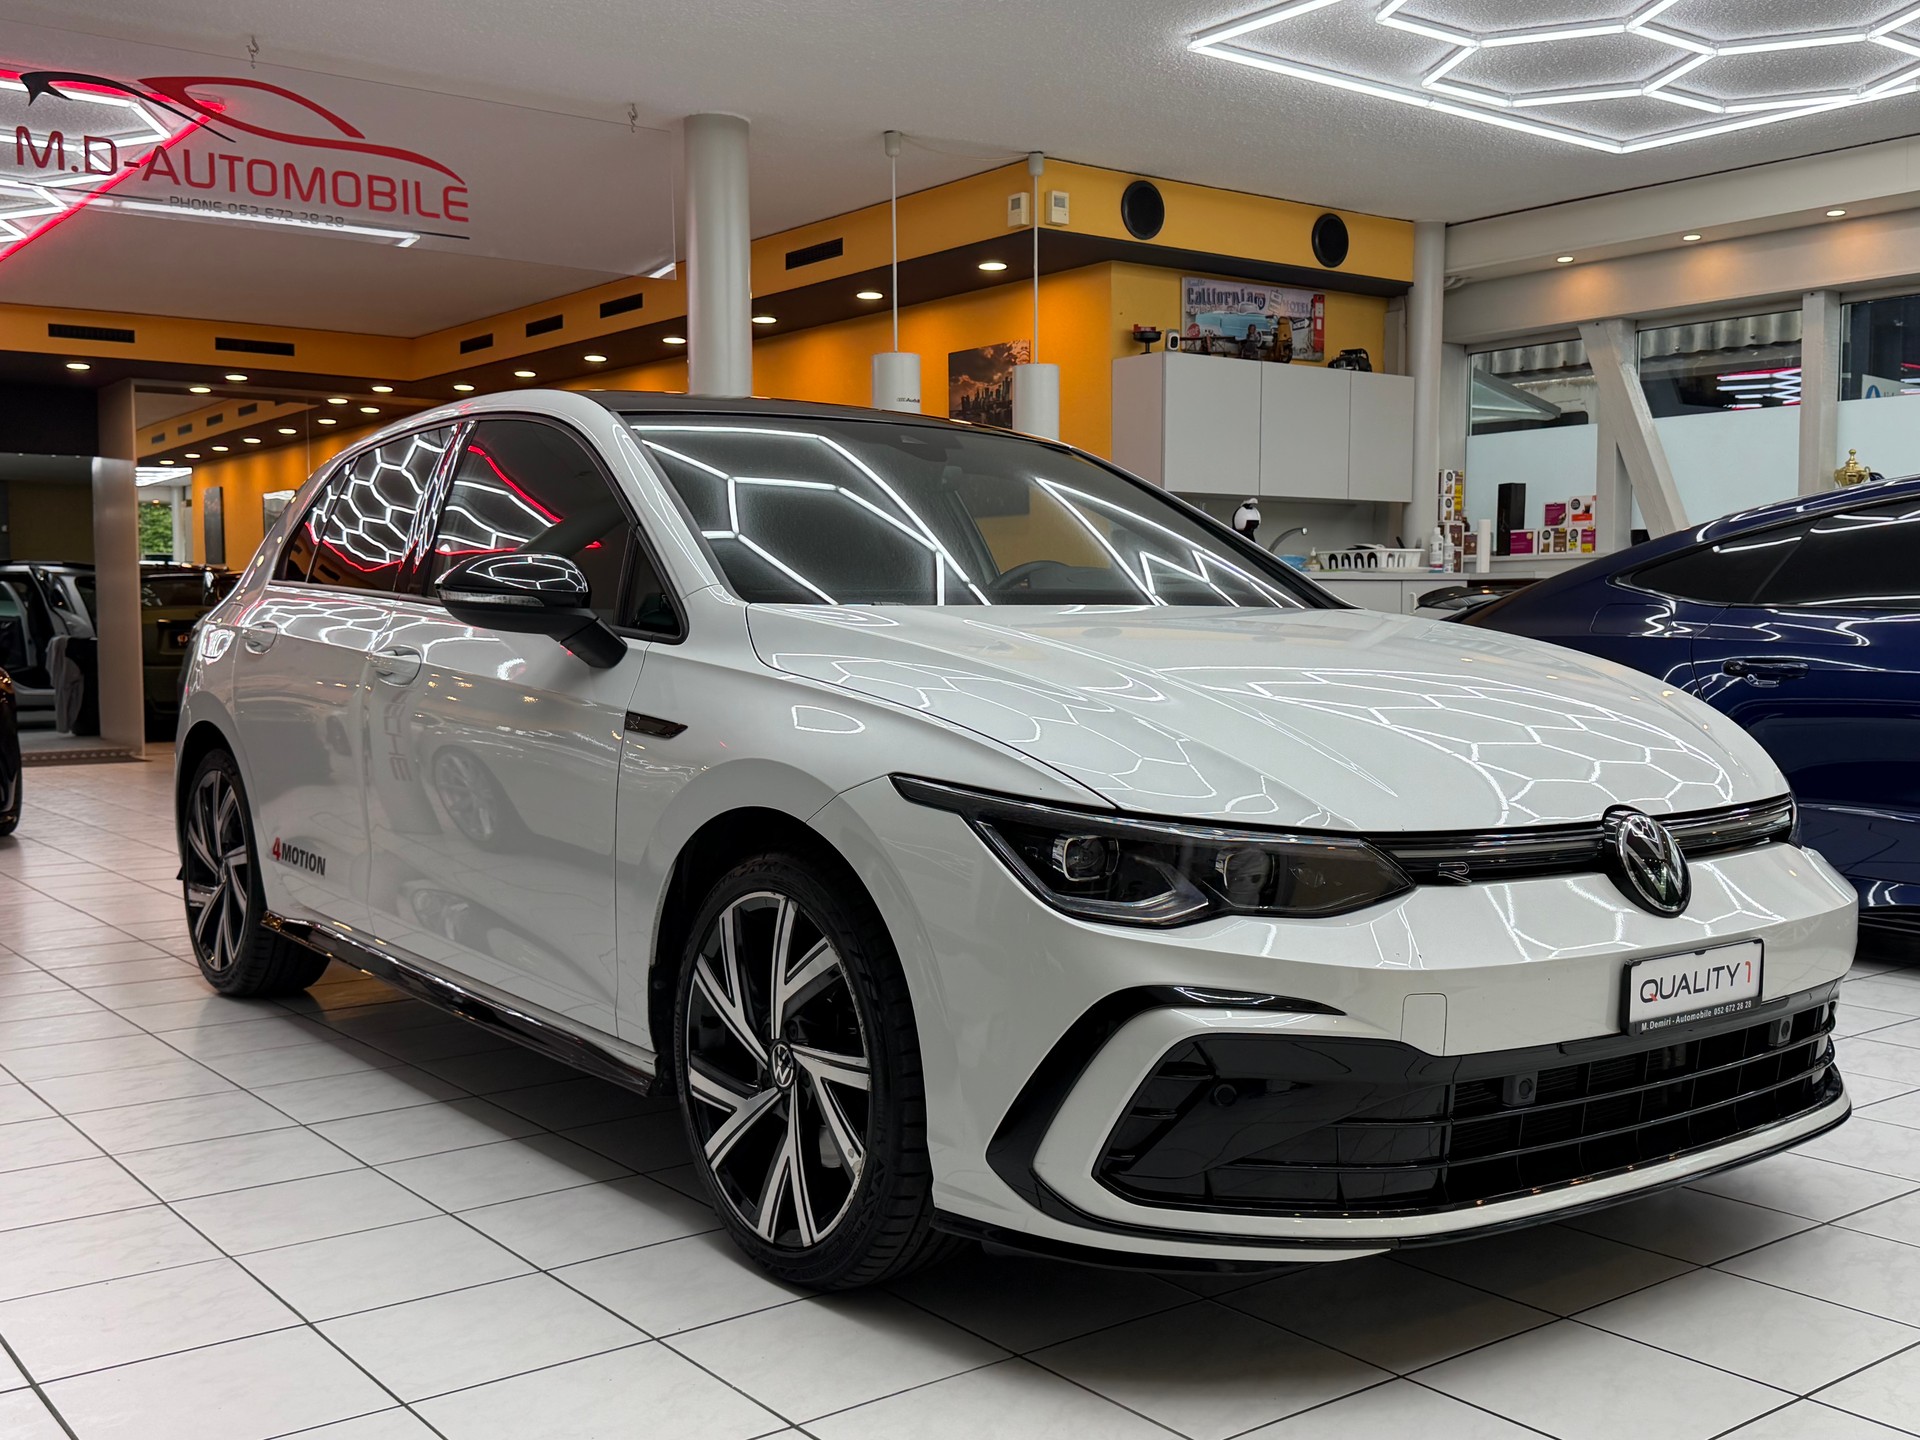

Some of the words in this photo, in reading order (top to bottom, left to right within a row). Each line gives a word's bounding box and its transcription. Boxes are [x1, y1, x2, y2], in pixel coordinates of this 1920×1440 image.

[1187, 287, 1255, 306] California
[1639, 962, 1741, 1004] QUALITY
[1745, 960, 1752, 984] 1
[1675, 1009, 1712, 1024] Automobile
[1713, 1007, 1725, 1016] 052
[1725, 1004, 1736, 1013] 672
[1736, 1002, 1744, 1011] 28
[1744, 1000, 1752, 1009] 28
